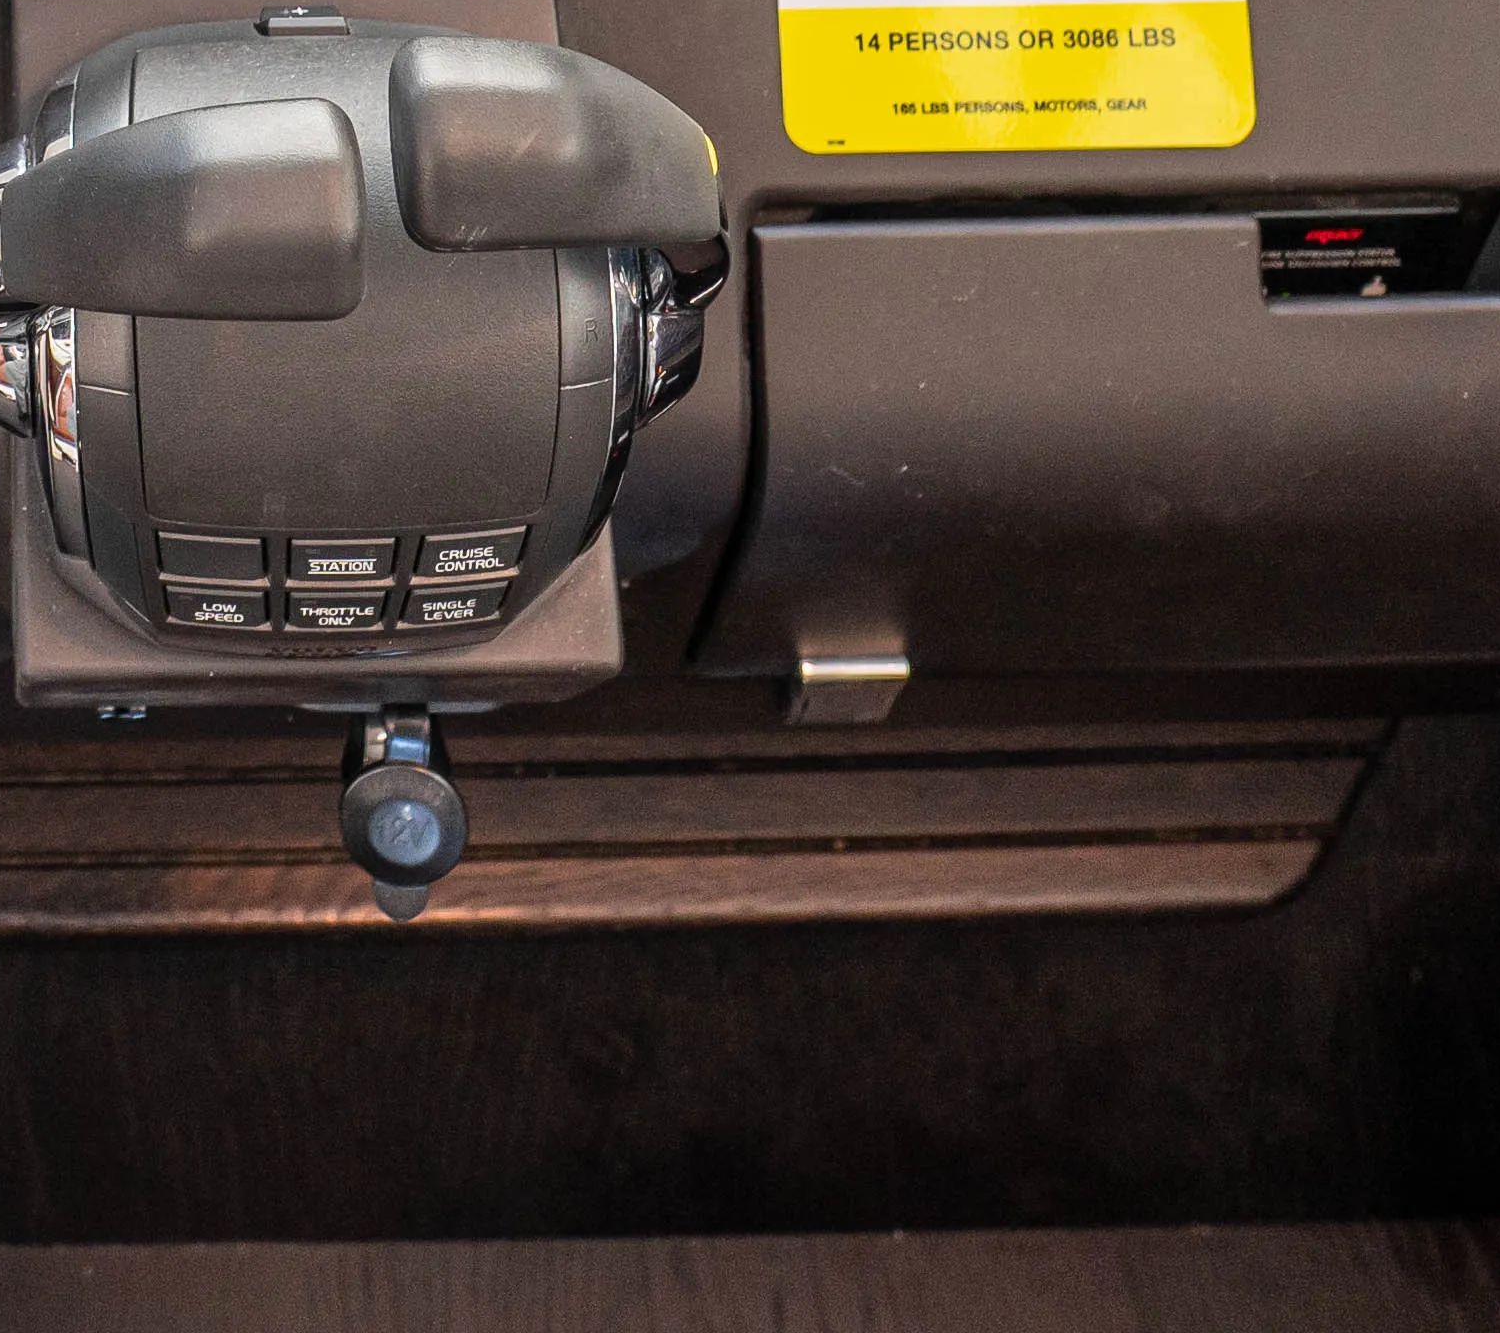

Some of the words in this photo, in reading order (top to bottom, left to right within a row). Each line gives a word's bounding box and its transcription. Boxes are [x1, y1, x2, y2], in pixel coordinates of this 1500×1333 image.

[855, 33, 880, 52] 14
[889, 30, 1009, 51] PERSONS
[1019, 30, 1054, 49] OR
[1063, 29, 1119, 49] 3086
[1128, 28, 1176, 47] LBS
[922, 103, 949, 114] LBS
[955, 101, 1029, 114] PERSONS,
[1034, 100, 1101, 113] MOTORS,
[1107, 99, 1147, 111] GEAR
[584, 318, 598, 343] R
[439, 547, 494, 560] CRUISE
[309, 561, 374, 572] STATION
[435, 557, 504, 572] CONTROL
[202, 603, 237, 613] LOW
[422, 599, 477, 611] SINGLE
[194, 612, 245, 623] SPEED
[300, 606, 374, 617] THROTTLE
[424, 608, 474, 621] LEVER
[318, 616, 355, 626] ONLY
